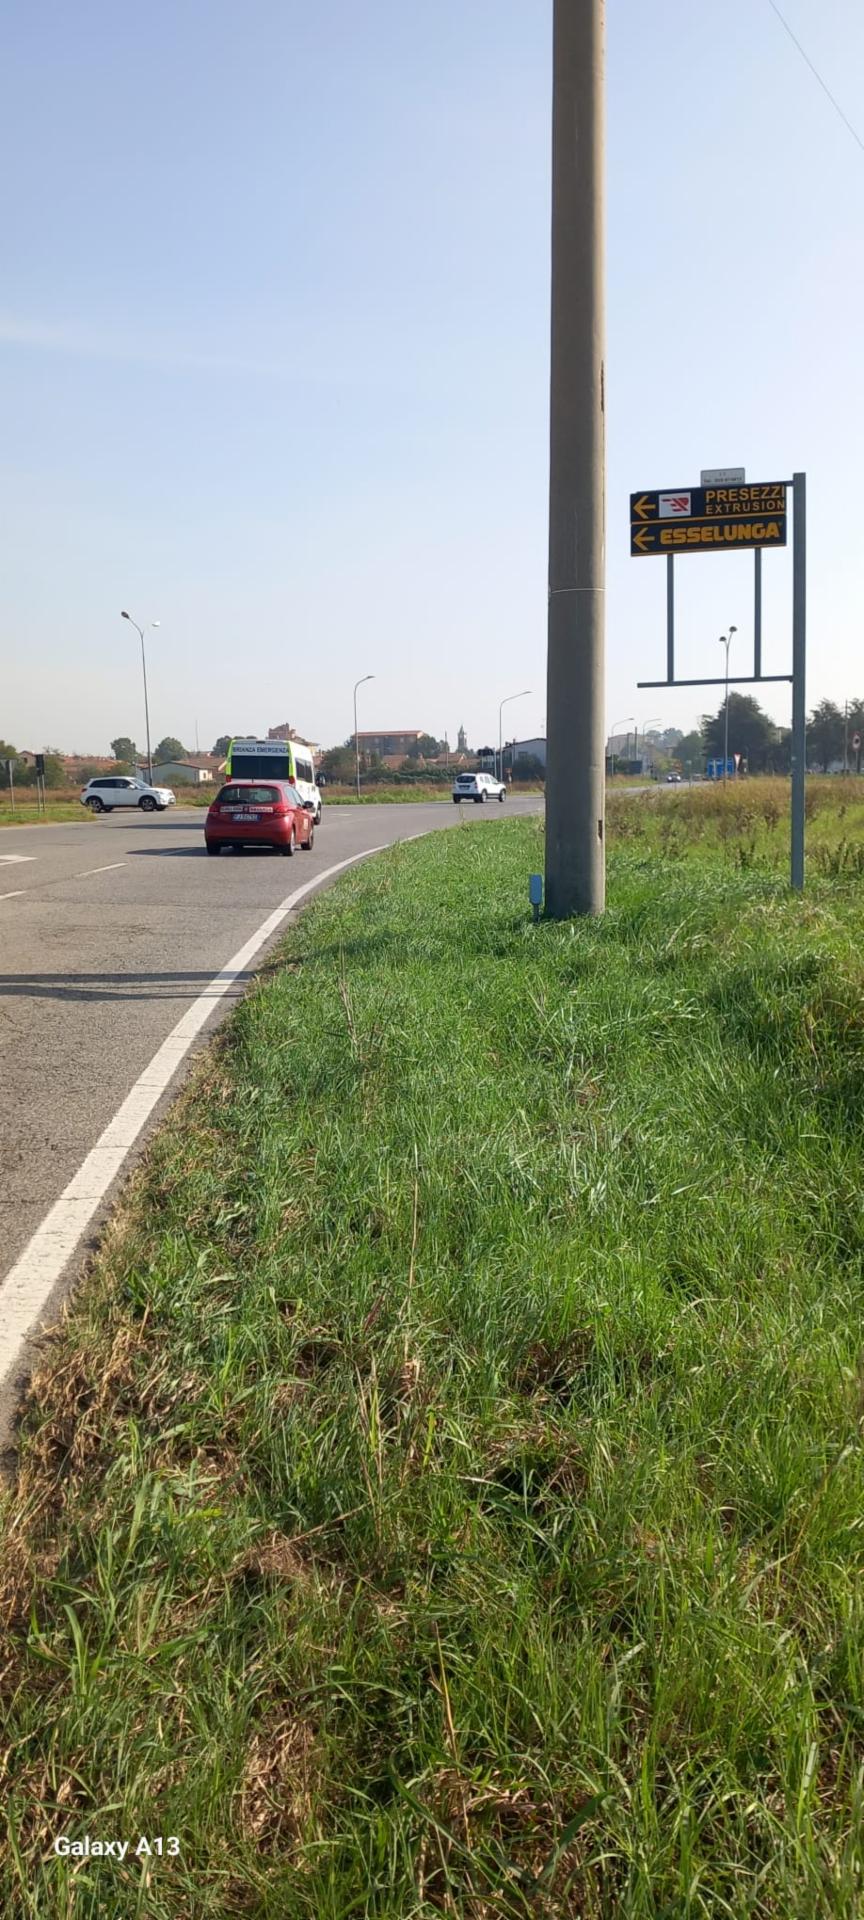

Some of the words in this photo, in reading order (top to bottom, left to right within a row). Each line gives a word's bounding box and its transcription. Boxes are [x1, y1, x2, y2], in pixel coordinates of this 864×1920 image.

[705, 485, 785, 503] PRESEZZI
[705, 500, 785, 514] EXTRUSION
[660, 522, 780, 544] ESSELUNGA
